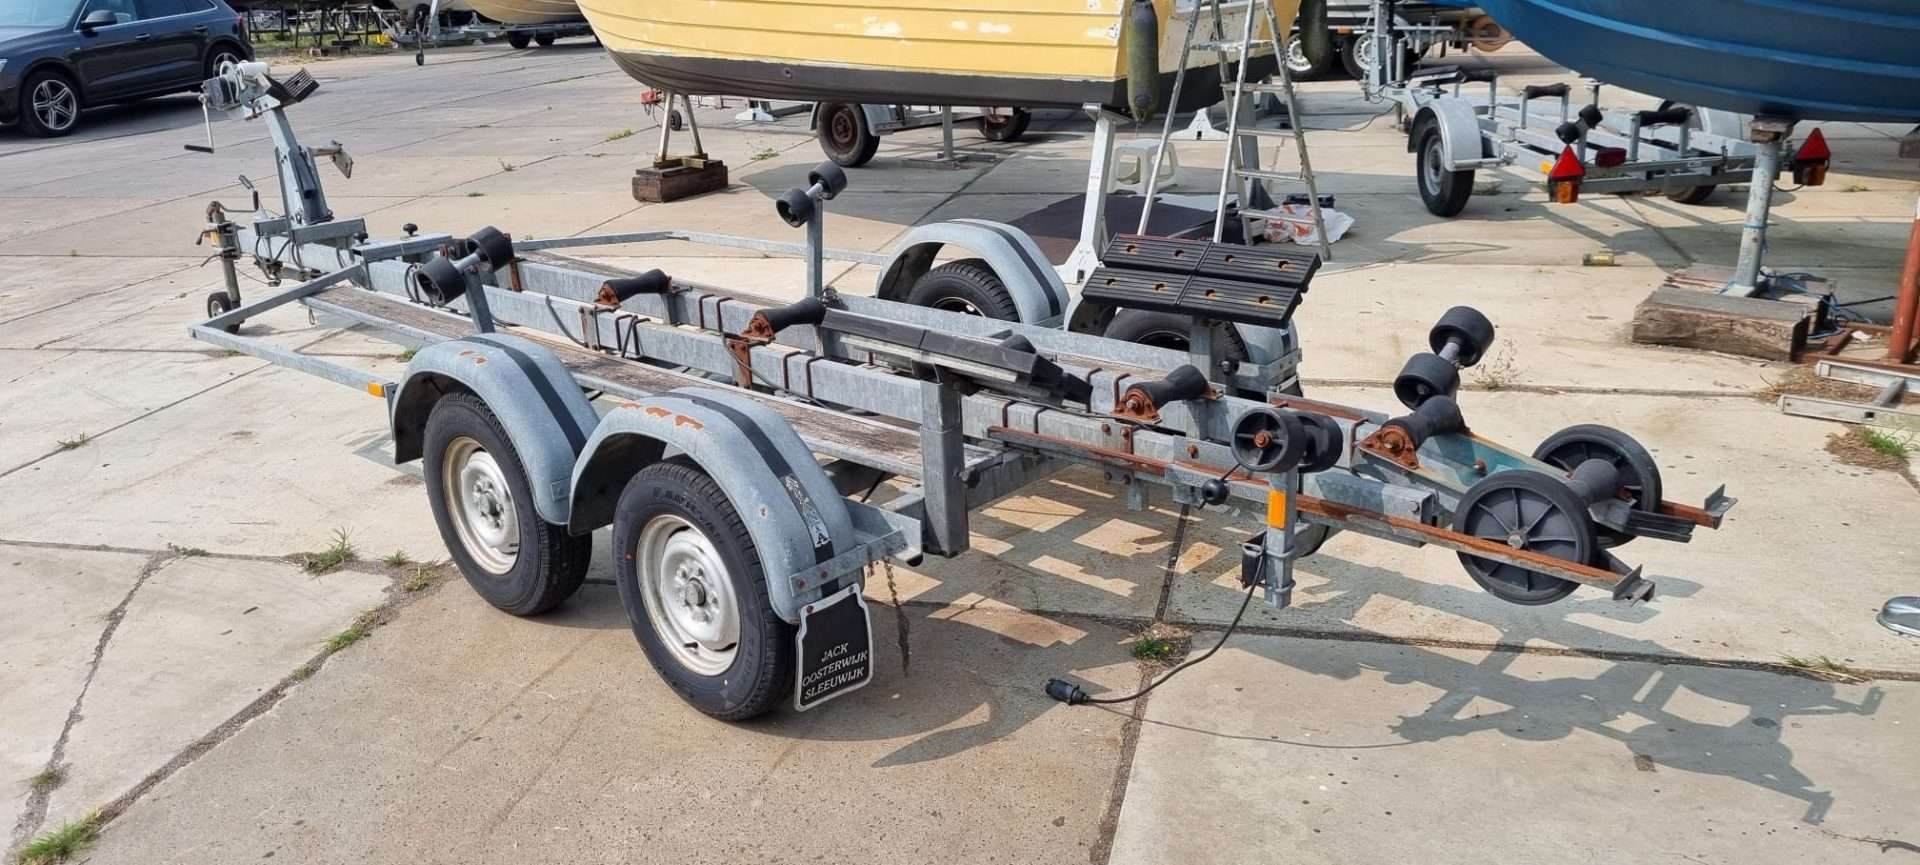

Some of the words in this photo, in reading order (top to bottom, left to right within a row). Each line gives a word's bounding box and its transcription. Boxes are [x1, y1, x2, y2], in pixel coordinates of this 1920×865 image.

[802, 650, 868, 687] OOSTERWIJK
[821, 642, 849, 662] JACK
[804, 666, 865, 700] SLEEUWIJK
